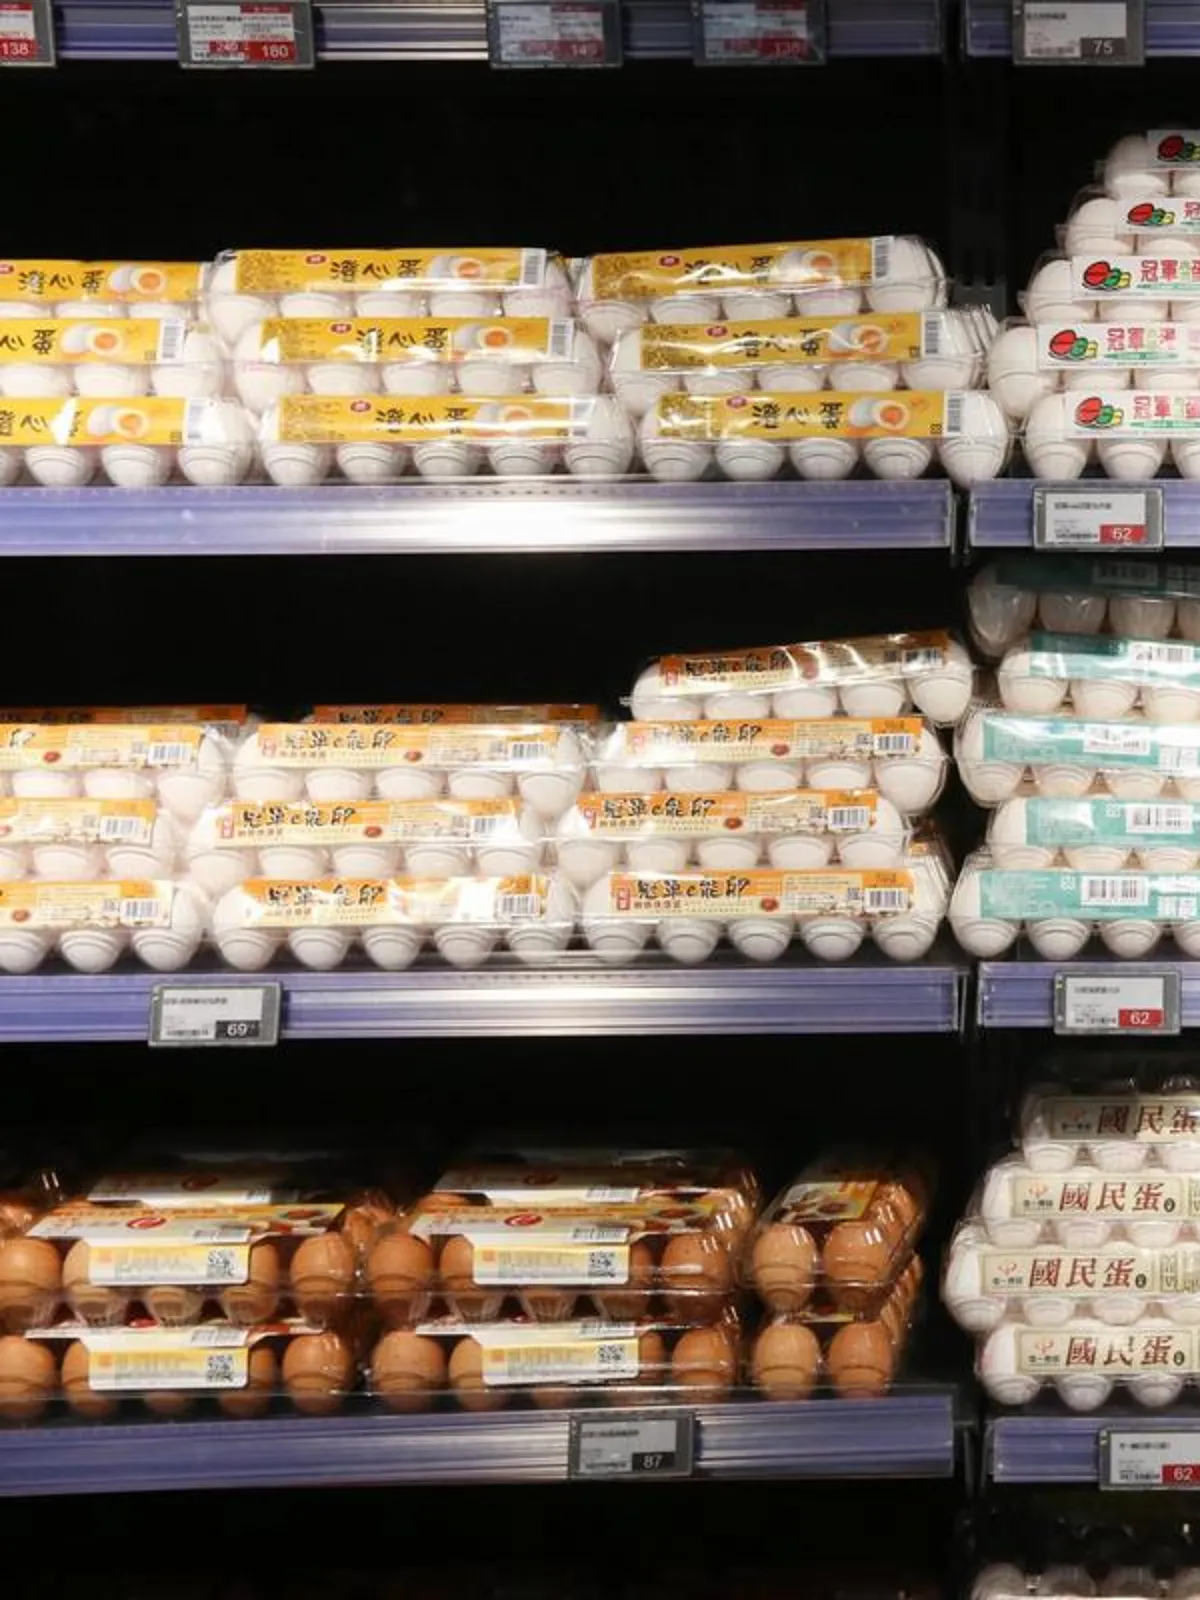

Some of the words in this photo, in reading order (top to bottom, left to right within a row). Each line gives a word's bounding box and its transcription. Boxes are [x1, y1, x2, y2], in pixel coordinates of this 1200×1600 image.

[1093, 40, 1113, 54] 75
[1129, 1011, 1150, 1025] 62
[227, 1023, 248, 1037] 69
[1096, 1104, 1199, 1136] 國民蛋
[1058, 1181, 1166, 1212] 國民蛋
[1028, 1257, 1137, 1289] 國民蛋
[1064, 1335, 1174, 1367] 國民蛋
[643, 1455, 663, 1469] 87
[1173, 1467, 1194, 1481] 62
